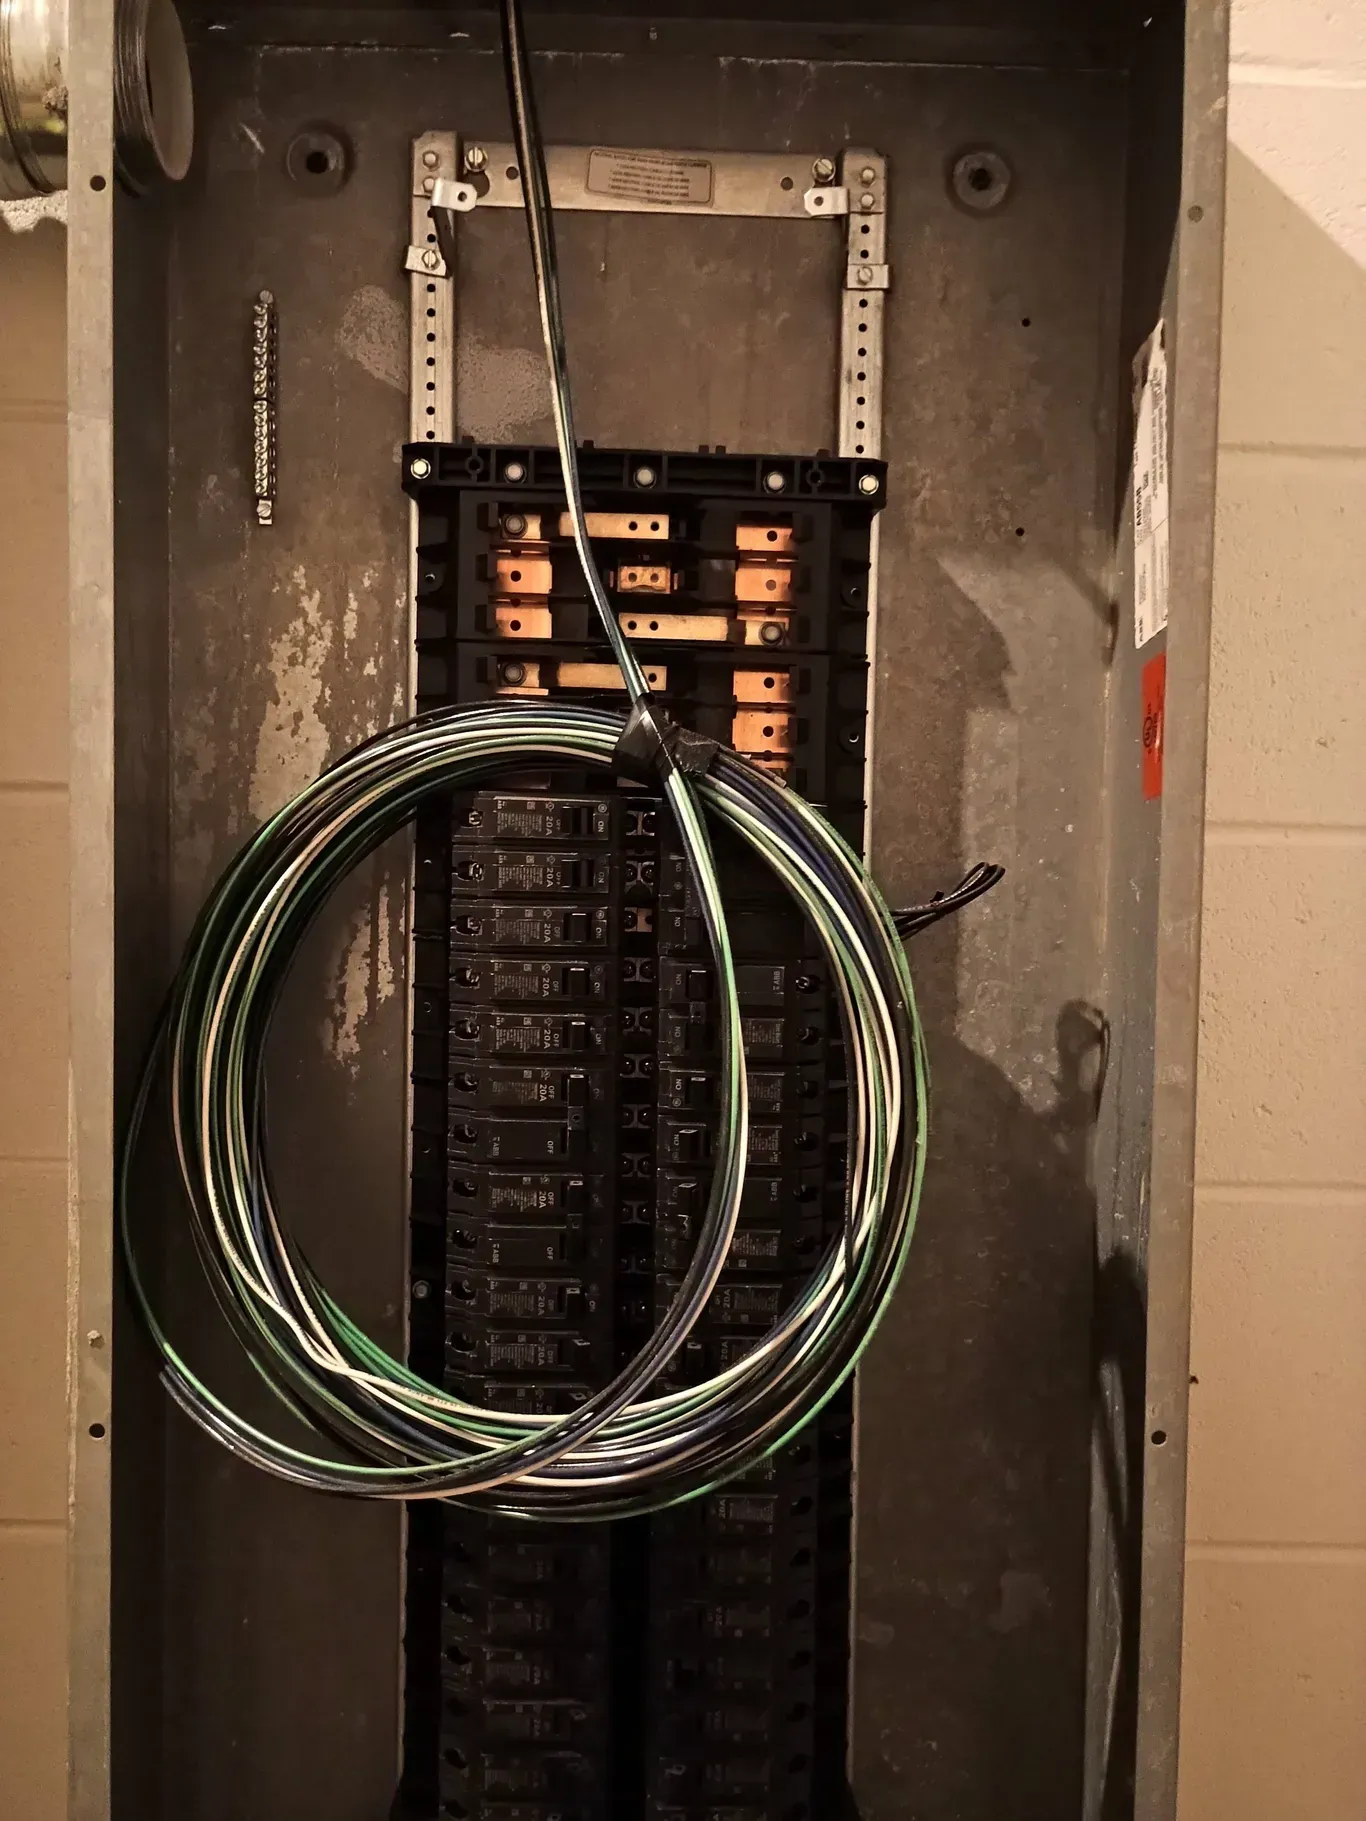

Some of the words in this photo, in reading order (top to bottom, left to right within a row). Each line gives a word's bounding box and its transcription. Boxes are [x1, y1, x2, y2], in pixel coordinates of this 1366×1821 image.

[545, 815, 553, 836] 20A
[597, 821, 604, 832] ON
[546, 867, 554, 888] 20A
[598, 871, 605, 883] ON
[674, 916, 681, 927] ON
[543, 923, 551, 943] 20A
[595, 927, 602, 939] ON
[542, 977, 550, 997] 20A
[675, 973, 682, 986] ON
[593, 982, 601, 994] ON
[595, 1033, 602, 1045] ON
[674, 1026, 681, 1038] ON
[675, 1078, 682, 1090] ON
[539, 1083, 547, 1102] 20A
[673, 1134, 680, 1146] ON
[539, 1190, 547, 1208] 20A
[546, 1246, 554, 1261] OFF
[537, 1295, 545, 1316] 20A
[723, 1288, 731, 1309] 20A
[537, 1346, 545, 1366] 20A
[720, 1340, 729, 1360] 20A
